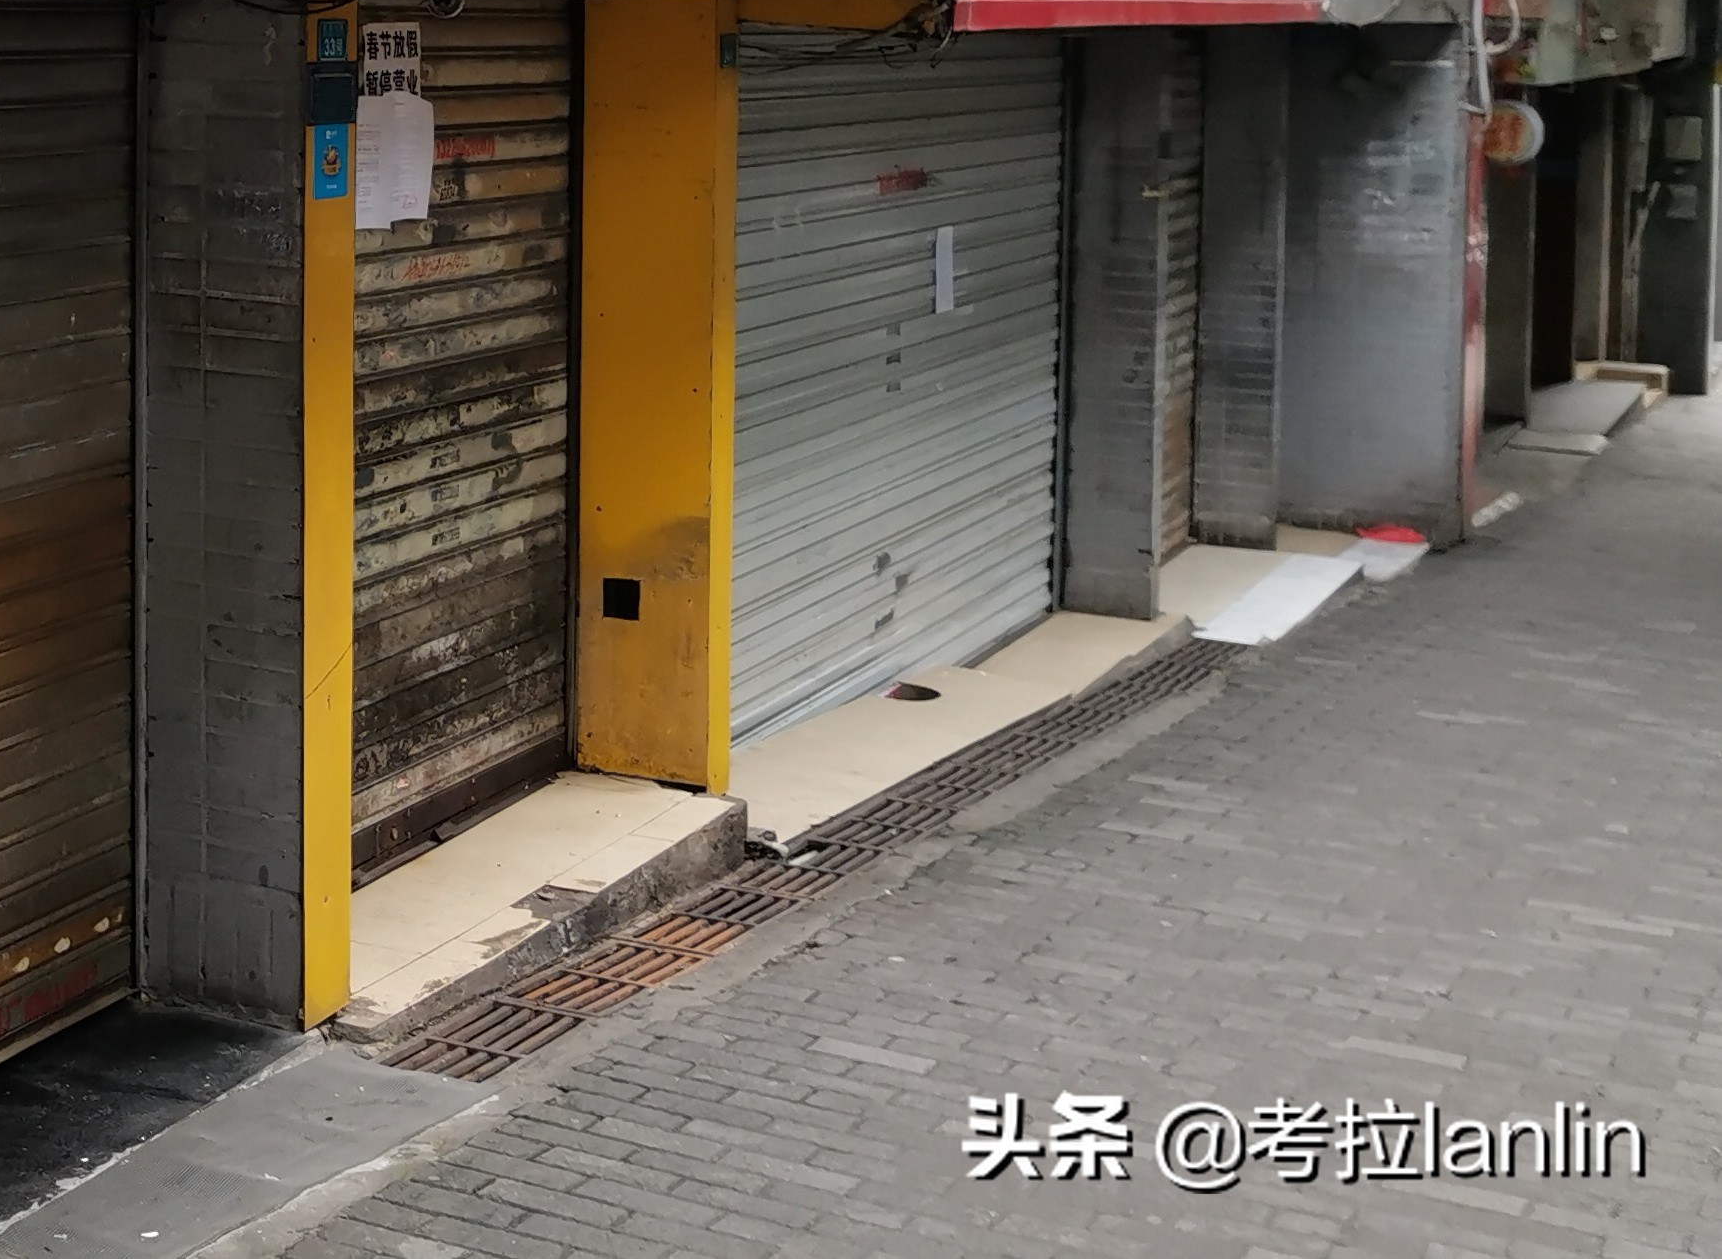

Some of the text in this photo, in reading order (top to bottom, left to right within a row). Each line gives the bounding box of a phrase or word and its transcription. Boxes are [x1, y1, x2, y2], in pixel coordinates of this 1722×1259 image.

[365, 29, 419, 61] 春节放假
[365, 68, 419, 96] 暂停营业
